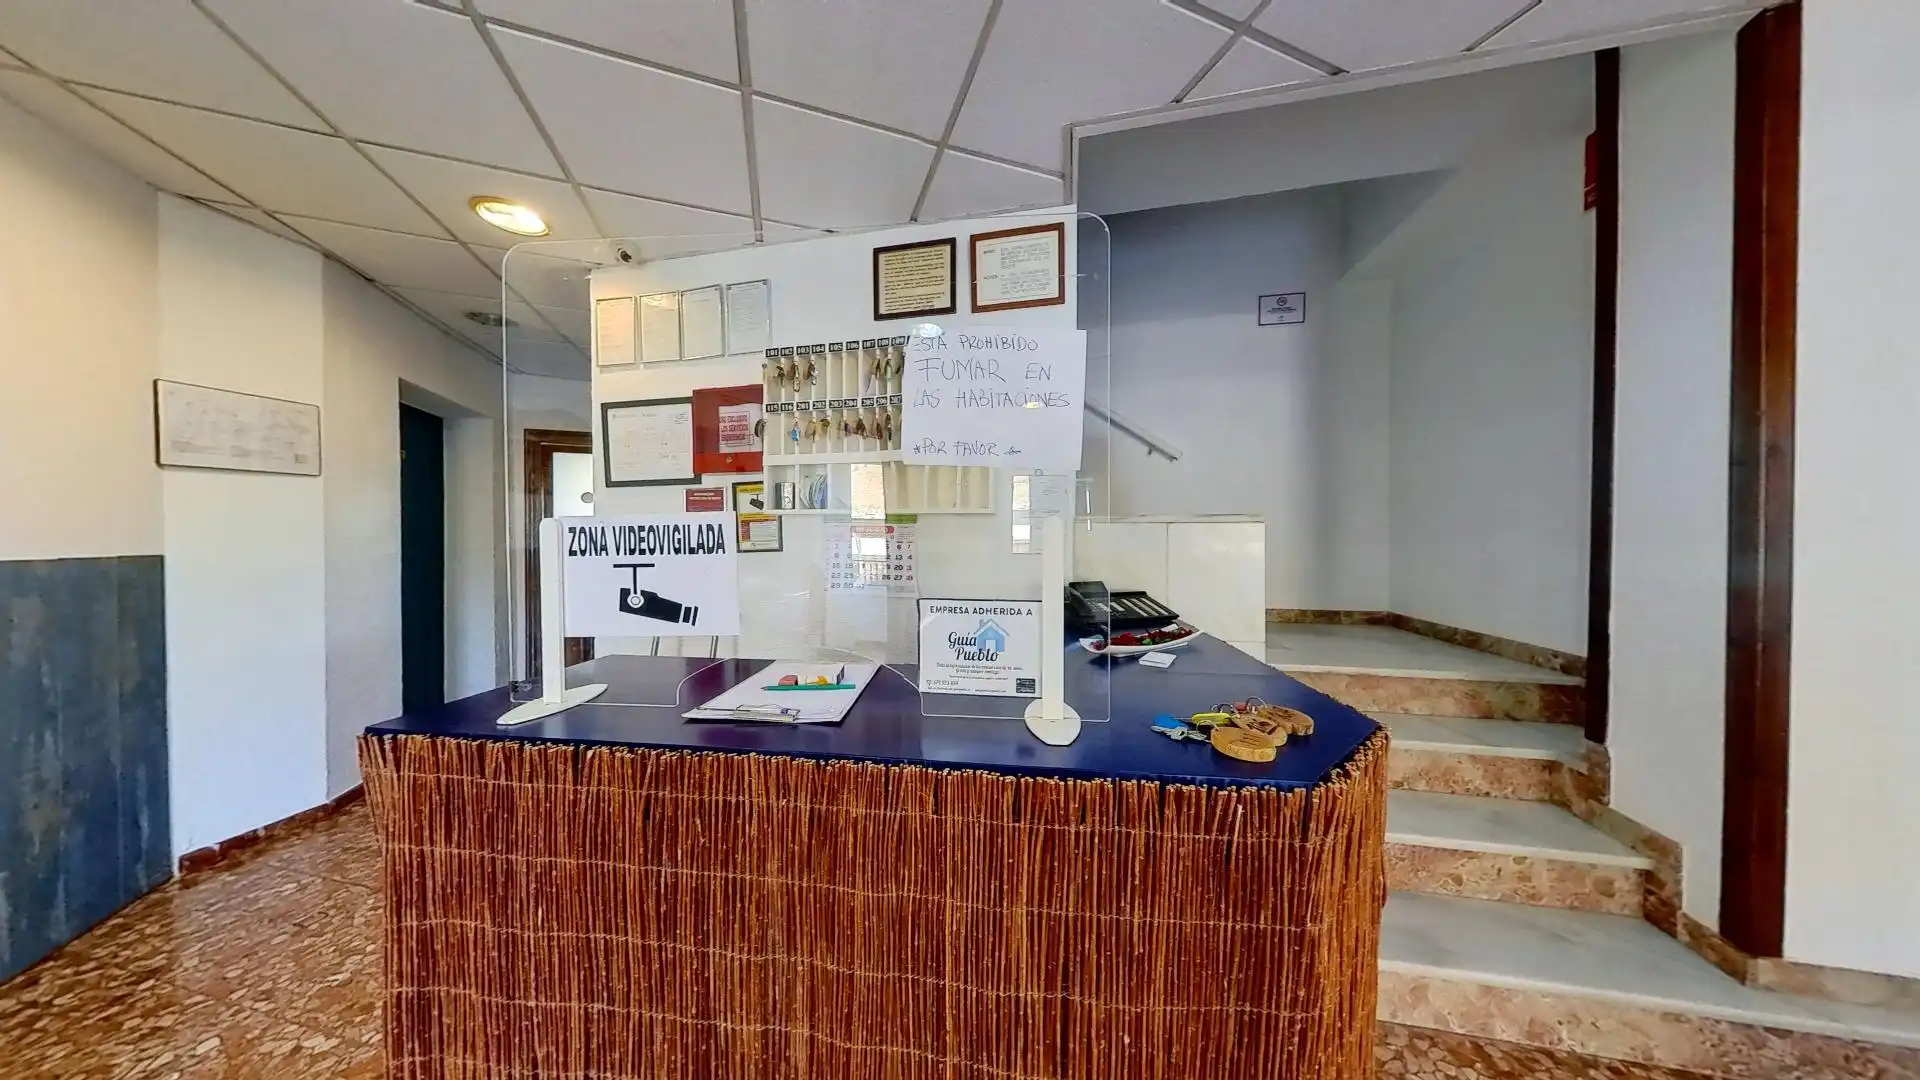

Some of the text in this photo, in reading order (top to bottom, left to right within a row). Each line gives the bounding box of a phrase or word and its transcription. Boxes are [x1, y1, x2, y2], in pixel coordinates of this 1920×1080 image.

[766, 348, 779, 357] 101
[781, 347, 794, 356] 102
[797, 346, 810, 355] 103
[812, 344, 825, 353] 104
[829, 342, 843, 352] 105
[846, 341, 859, 350] 106
[863, 339, 876, 349] 107
[959, 333, 1039, 351] PROHIBIDO
[913, 357, 1052, 382] FUMAR EN
[766, 404, 779, 412] 115
[781, 403, 794, 411] 116
[797, 402, 809, 410] 201
[812, 401, 826, 409] 202
[829, 400, 843, 408] 203
[844, 399, 857, 408] 204
[913, 387, 1071, 409] LAS HABITACIONES
[922, 437, 1000, 457] POR FAVOR
[568, 526, 609, 557] ZONA
[612, 523, 726, 557] VIDEOVIGILADA
[930, 605, 1033, 616] EMPRESA ADHERIDA A
[948, 631, 977, 649] Guía
[954, 647, 999, 662] Pueblo
